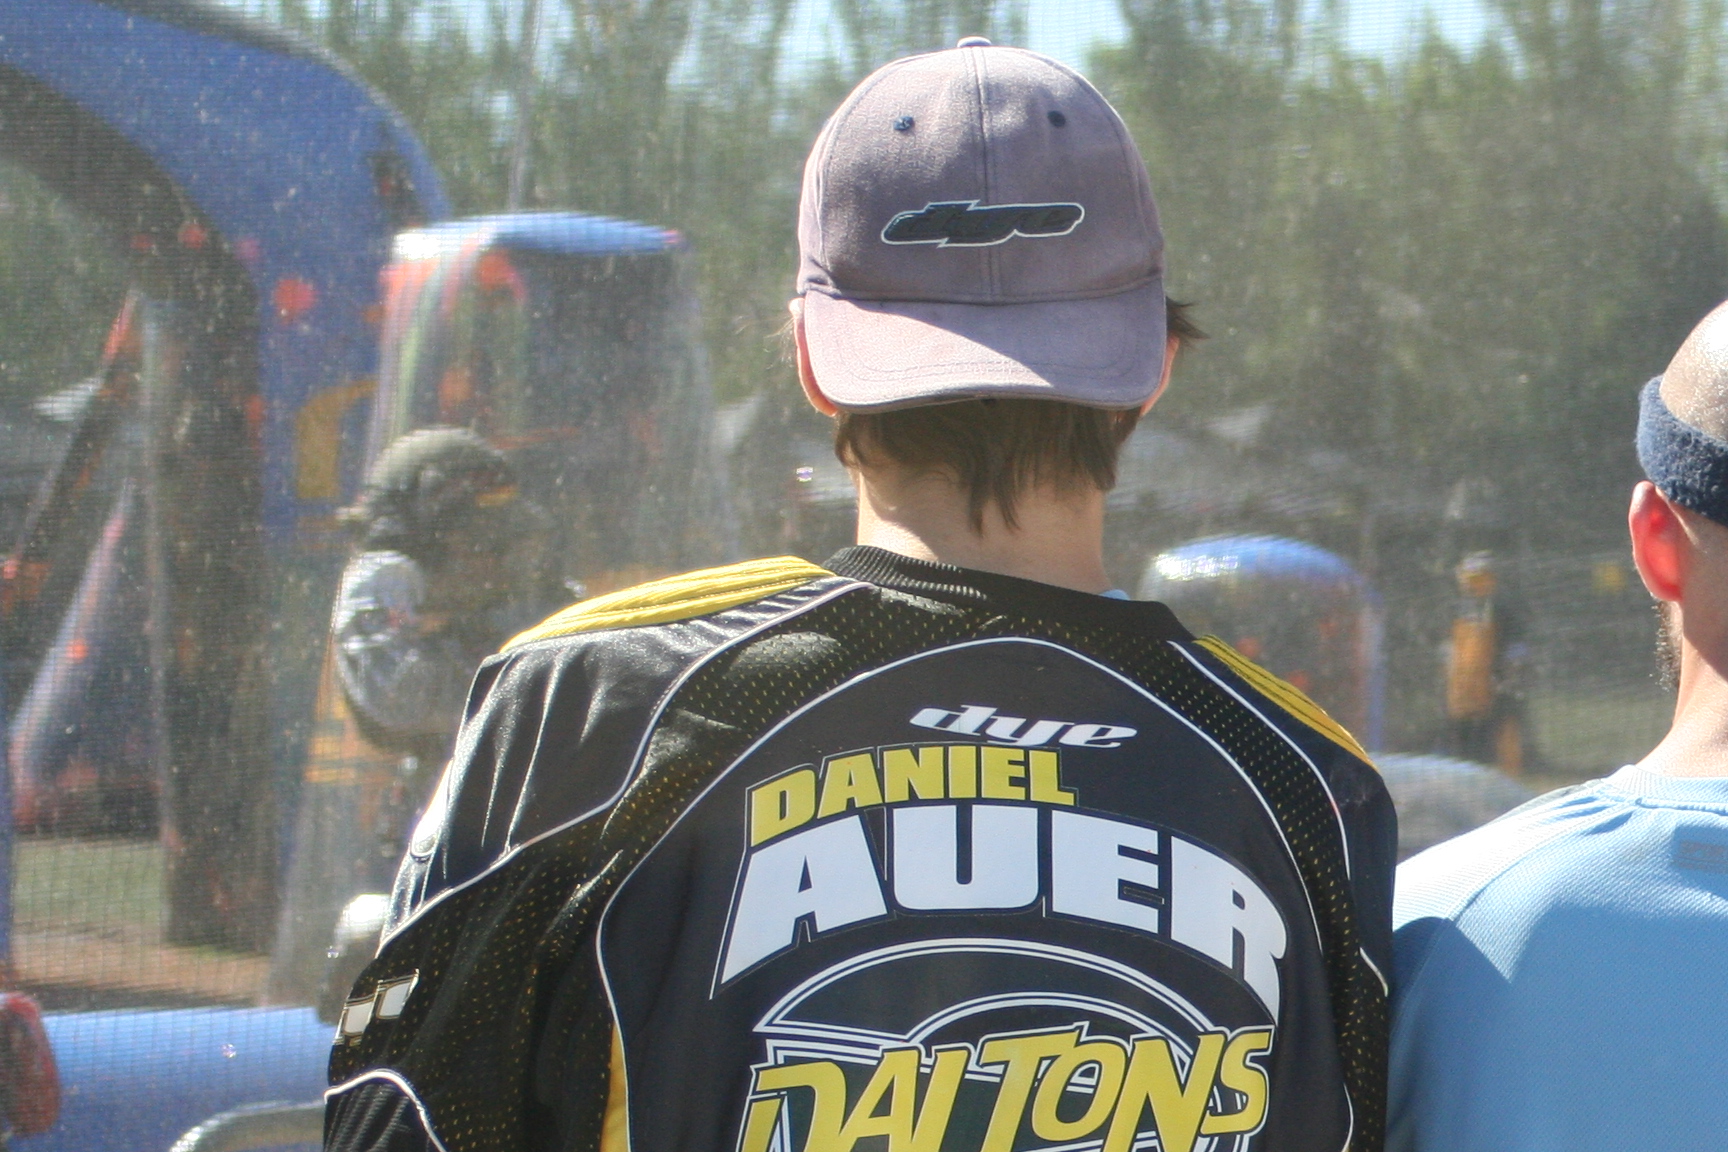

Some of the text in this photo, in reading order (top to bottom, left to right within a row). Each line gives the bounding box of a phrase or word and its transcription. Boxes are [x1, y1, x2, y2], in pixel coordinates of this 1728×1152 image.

[908, 704, 1138, 747] dye
[750, 745, 1076, 848] DANIEL
[720, 804, 1288, 1027] AUER
